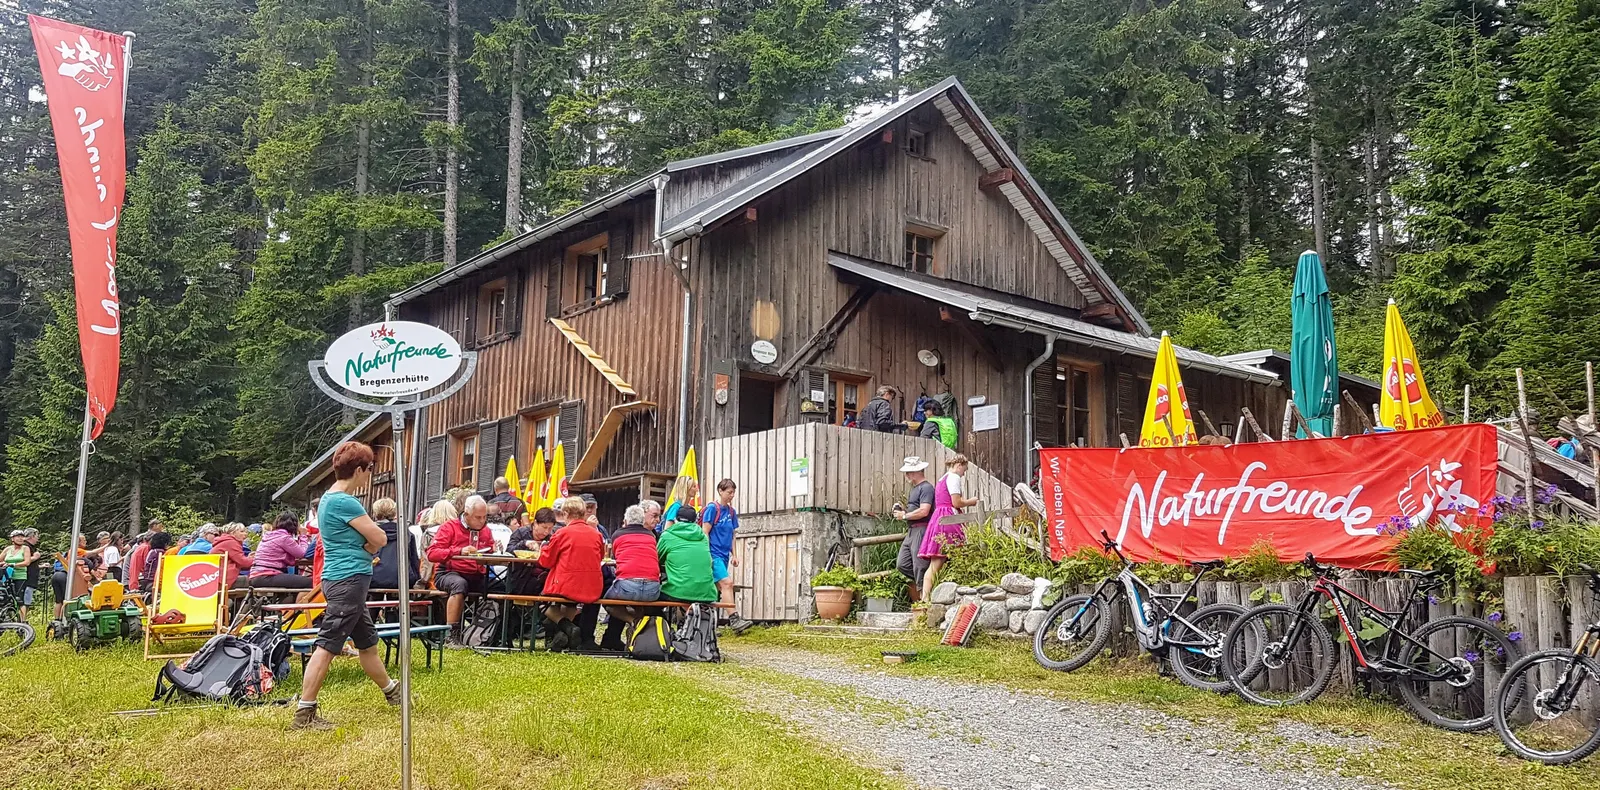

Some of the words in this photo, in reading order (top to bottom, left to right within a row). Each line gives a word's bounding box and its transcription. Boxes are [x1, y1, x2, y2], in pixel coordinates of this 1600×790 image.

[345, 341, 453, 386] Naturfreunde
[360, 375, 429, 387] Bregenzerhütte
[1115, 461, 1384, 550] Naturfreunde
